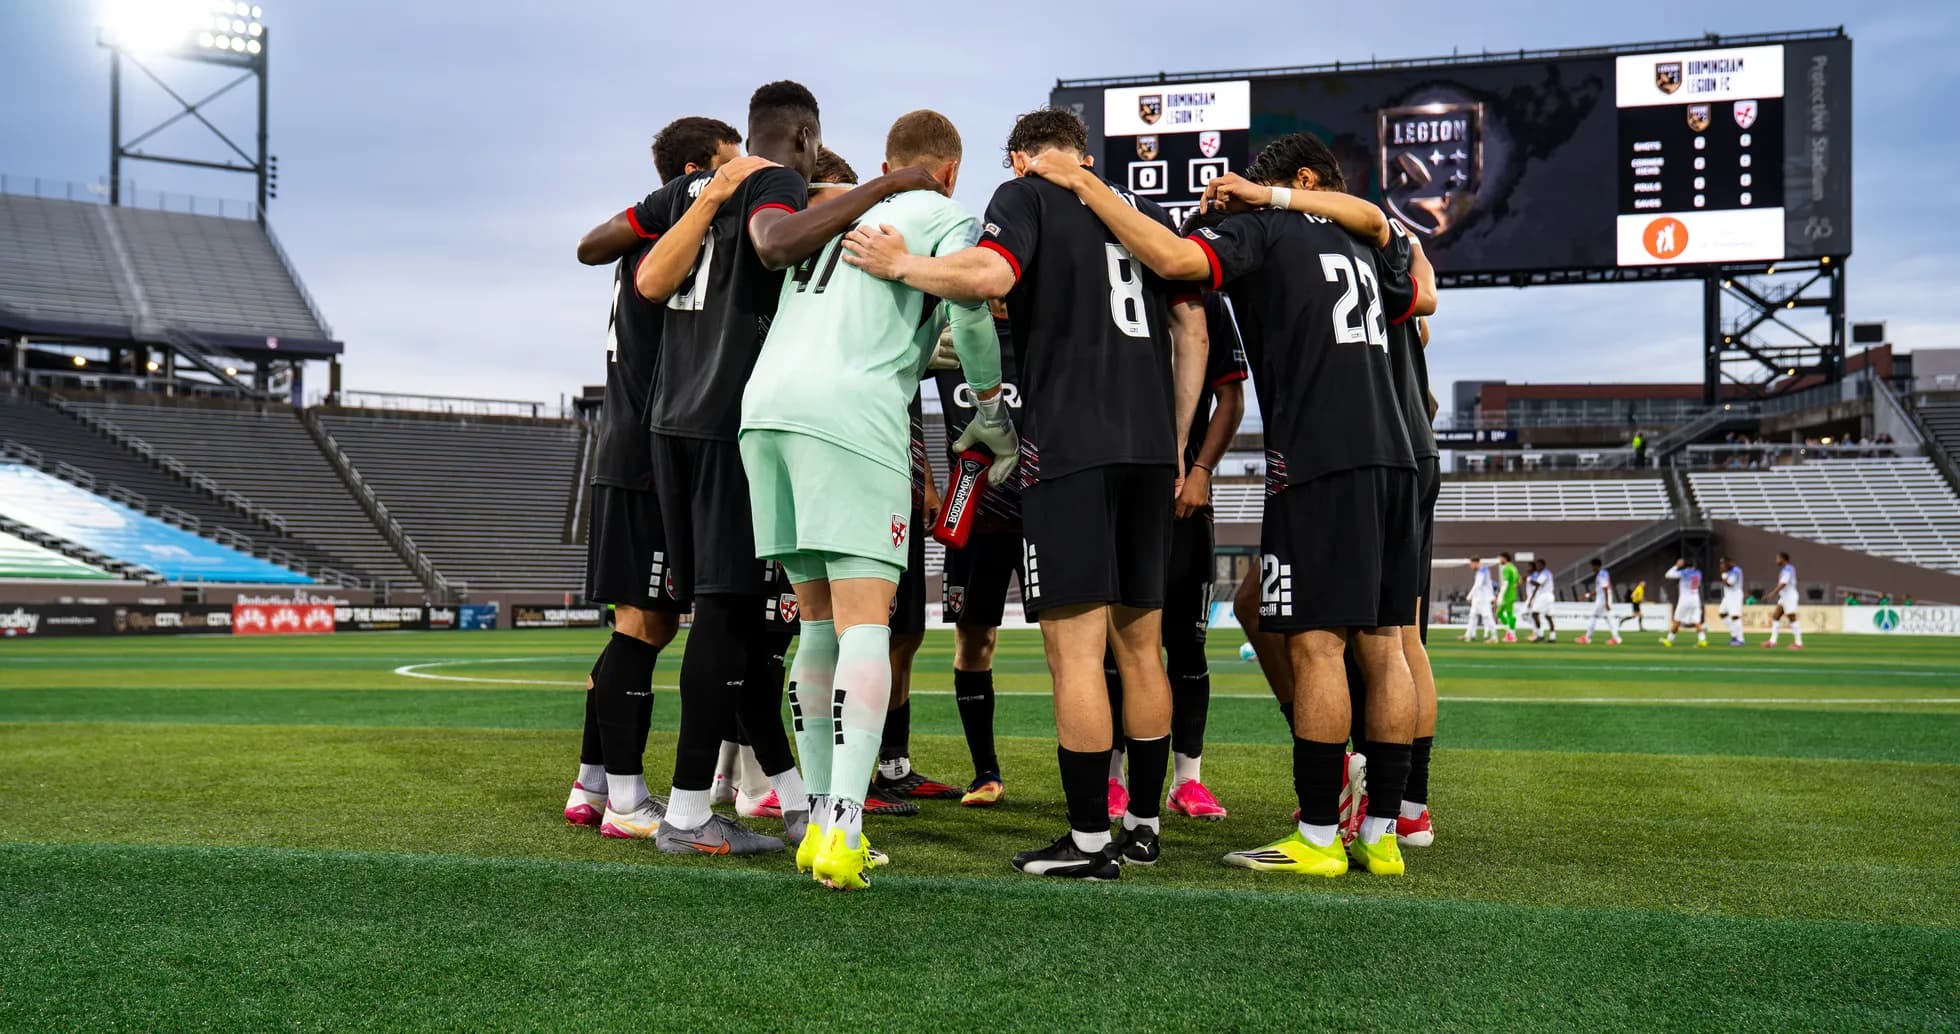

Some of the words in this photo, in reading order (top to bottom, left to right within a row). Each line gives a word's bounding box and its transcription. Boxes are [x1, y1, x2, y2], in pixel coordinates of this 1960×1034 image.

[1688, 58, 1744, 75] BIRMINGHAM
[1688, 78, 1716, 92] LEGION
[1812, 55, 1828, 132] Protective
[1167, 92, 1216, 107] BIRMINGHAM
[1167, 109, 1192, 124] LEGION
[1394, 120, 1467, 144] LEGION
[1140, 168, 1157, 188] 0
[1200, 165, 1217, 186] 0
[1812, 136, 1828, 201] Stadium
[1105, 242, 1150, 337] 8
[1319, 253, 1388, 354] 22
[948, 474, 973, 524] BODYARMOR
[401, 607, 422, 622] CITY
